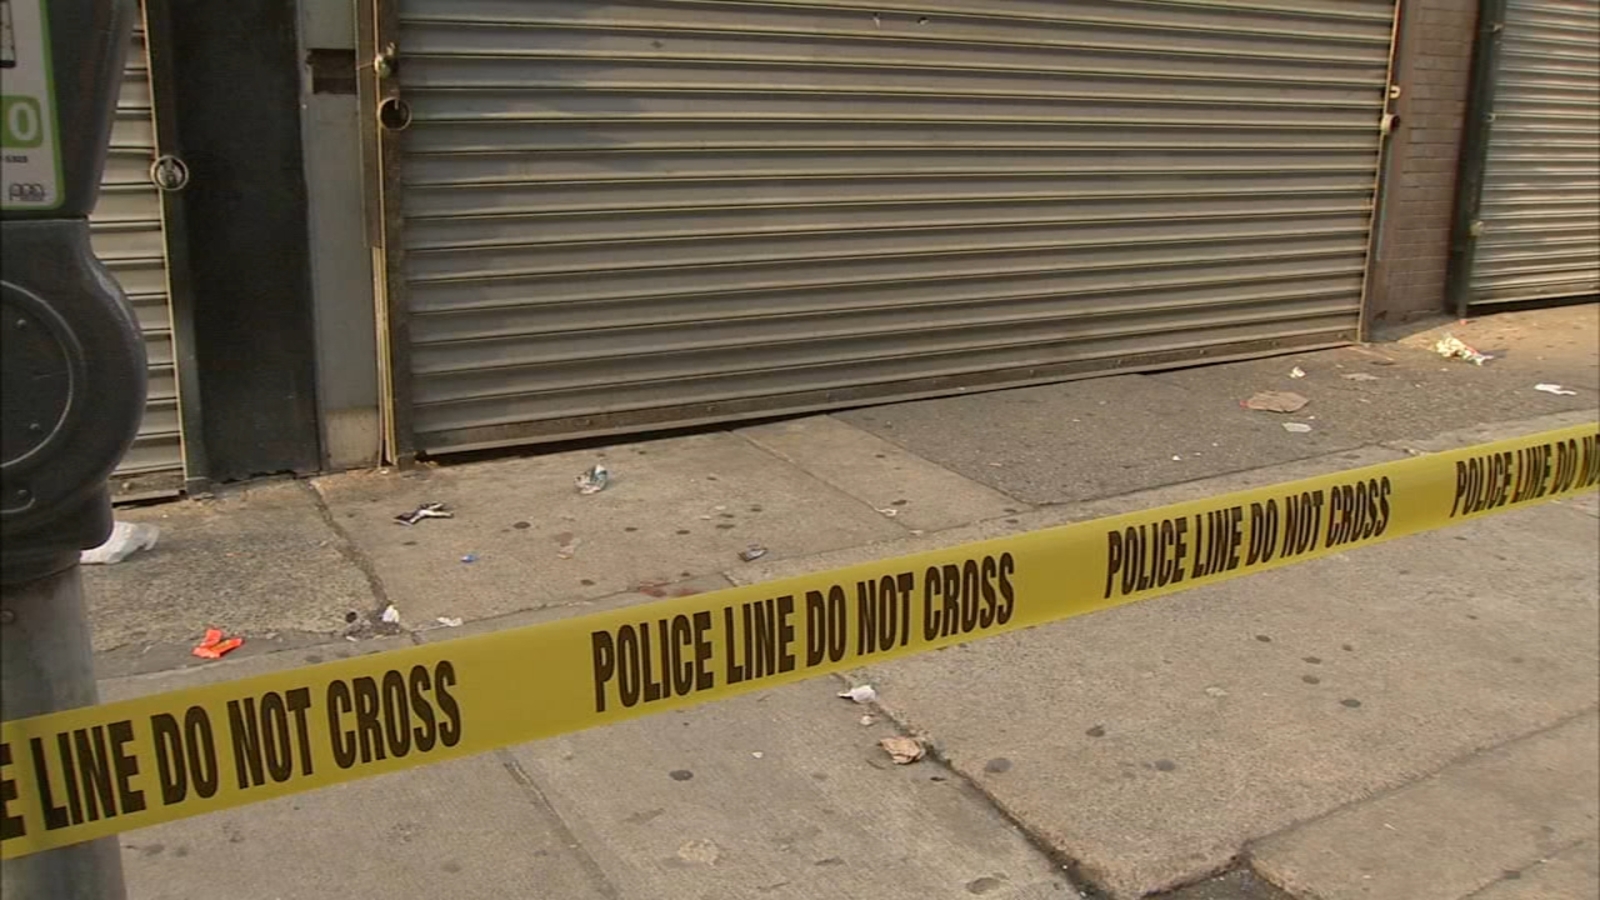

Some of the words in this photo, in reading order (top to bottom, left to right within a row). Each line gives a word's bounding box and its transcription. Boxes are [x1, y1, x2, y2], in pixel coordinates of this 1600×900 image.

[1104, 517, 1187, 598] POLICE
[1191, 506, 1243, 579] LINE
[1245, 499, 1278, 566] DO
[1280, 490, 1324, 559] NOT
[1325, 476, 1391, 548] CROSS
[1450, 452, 1512, 518] POLICE
[1511, 444, 1551, 503] LINE
[1549, 437, 1578, 495] DO
[591, 611, 714, 713] POLICE
[724, 595, 795, 684] LINE
[806, 585, 846, 667] DO
[857, 571, 914, 655] NOT
[924, 552, 1014, 641] CROSS
[30, 720, 146, 830] LINE
[151, 705, 218, 805] DO
[227, 687, 313, 789] NOT
[327, 660, 461, 769] CROSS
